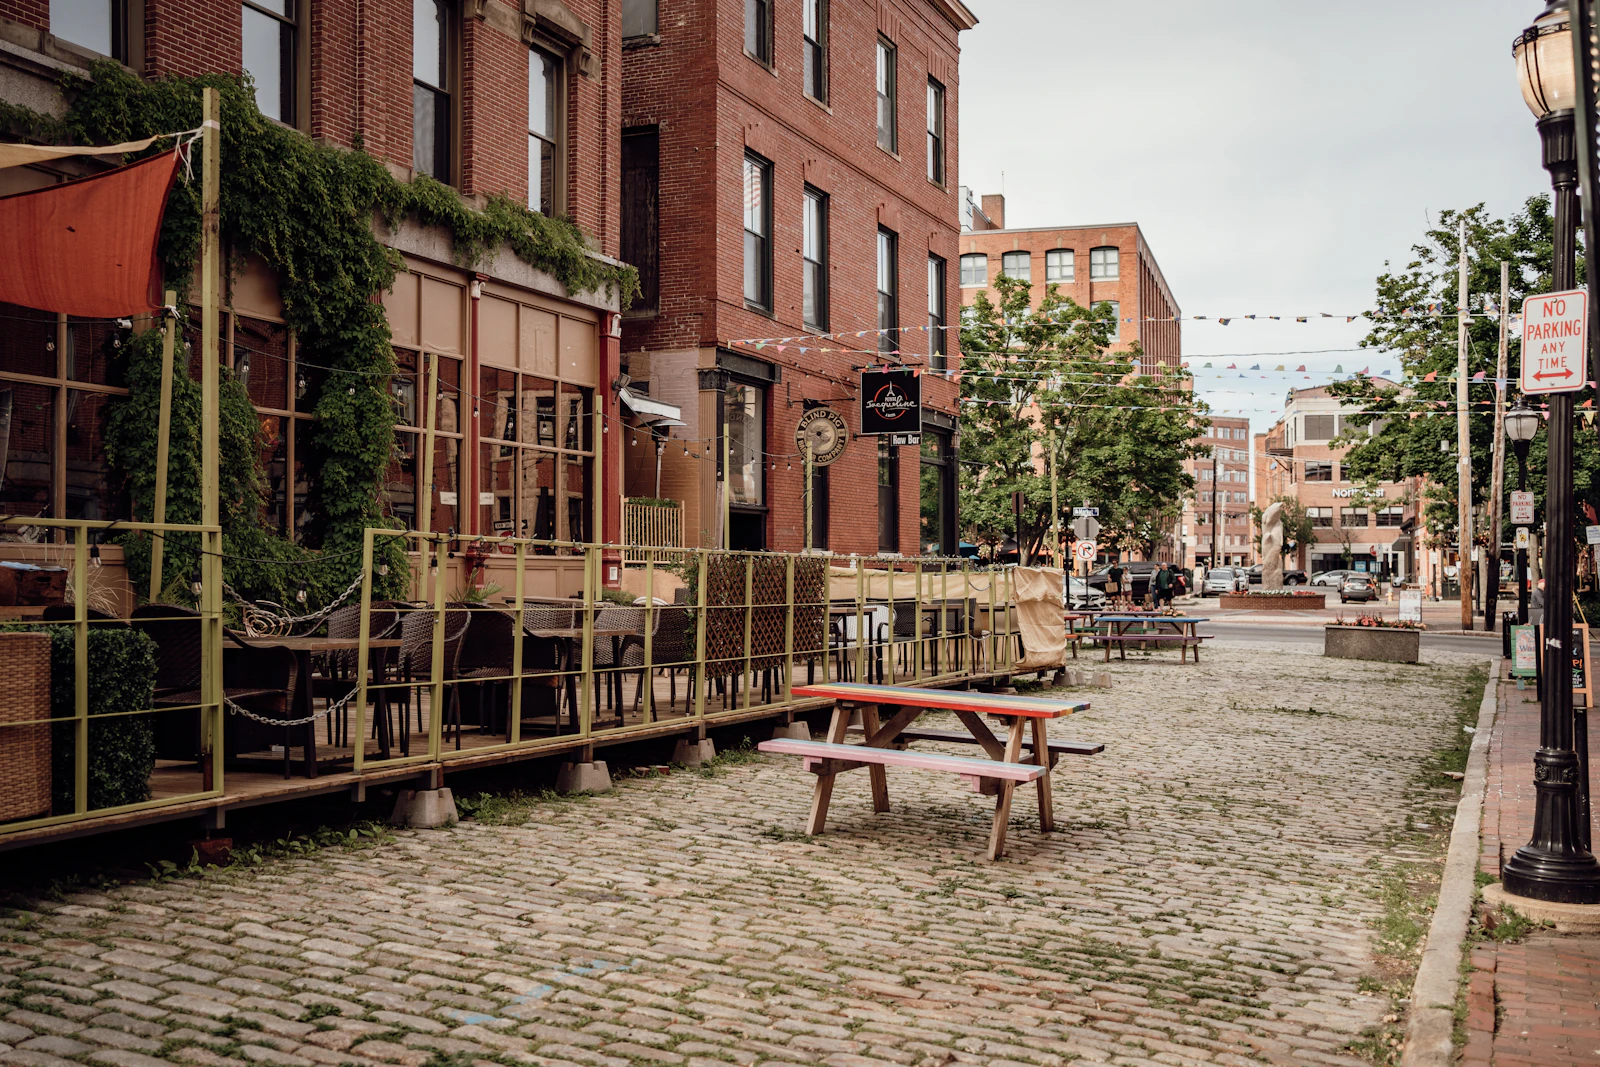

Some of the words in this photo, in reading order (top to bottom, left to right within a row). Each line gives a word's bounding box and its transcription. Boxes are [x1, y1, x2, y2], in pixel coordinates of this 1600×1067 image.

[1543, 299, 1566, 317] NO
[1527, 319, 1581, 340] PARKING
[1541, 341, 1565, 354] ANY
[1538, 356, 1567, 369] TIME
[801, 411, 826, 428] BLIND
[828, 413, 842, 427] PIG
[893, 435, 906, 444] Raw
[908, 434, 920, 444] Bar
[818, 438, 844, 462] COMPANY
